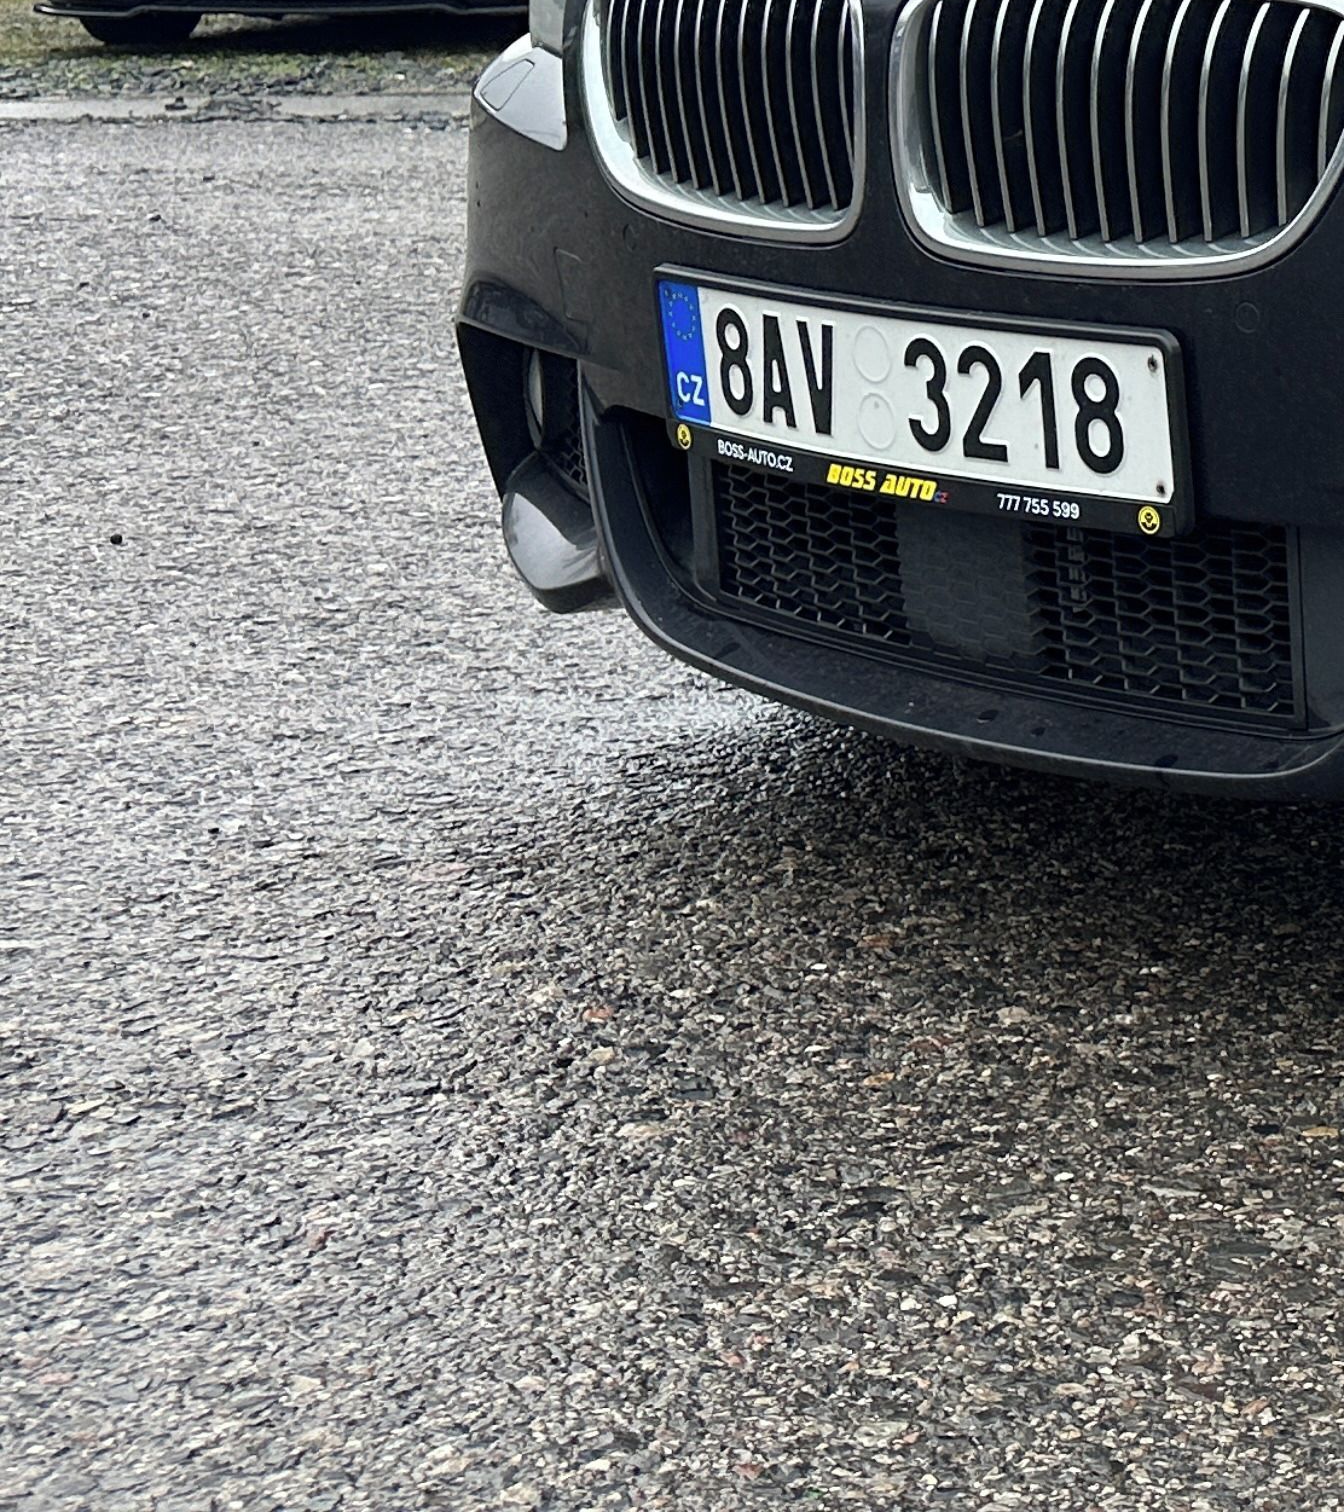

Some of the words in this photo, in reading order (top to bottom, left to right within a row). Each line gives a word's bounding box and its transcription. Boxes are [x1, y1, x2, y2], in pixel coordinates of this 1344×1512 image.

[675, 371, 706, 407] CZ
[714, 305, 834, 436] 8AV
[904, 336, 1125, 475] 3218
[717, 438, 794, 472] BOSS-AUTO.CZ
[826, 463, 877, 490] BOSS
[879, 474, 937, 502] AUTO
[997, 493, 1021, 512] 777
[1023, 497, 1049, 515] 755
[1052, 501, 1080, 520] 599
